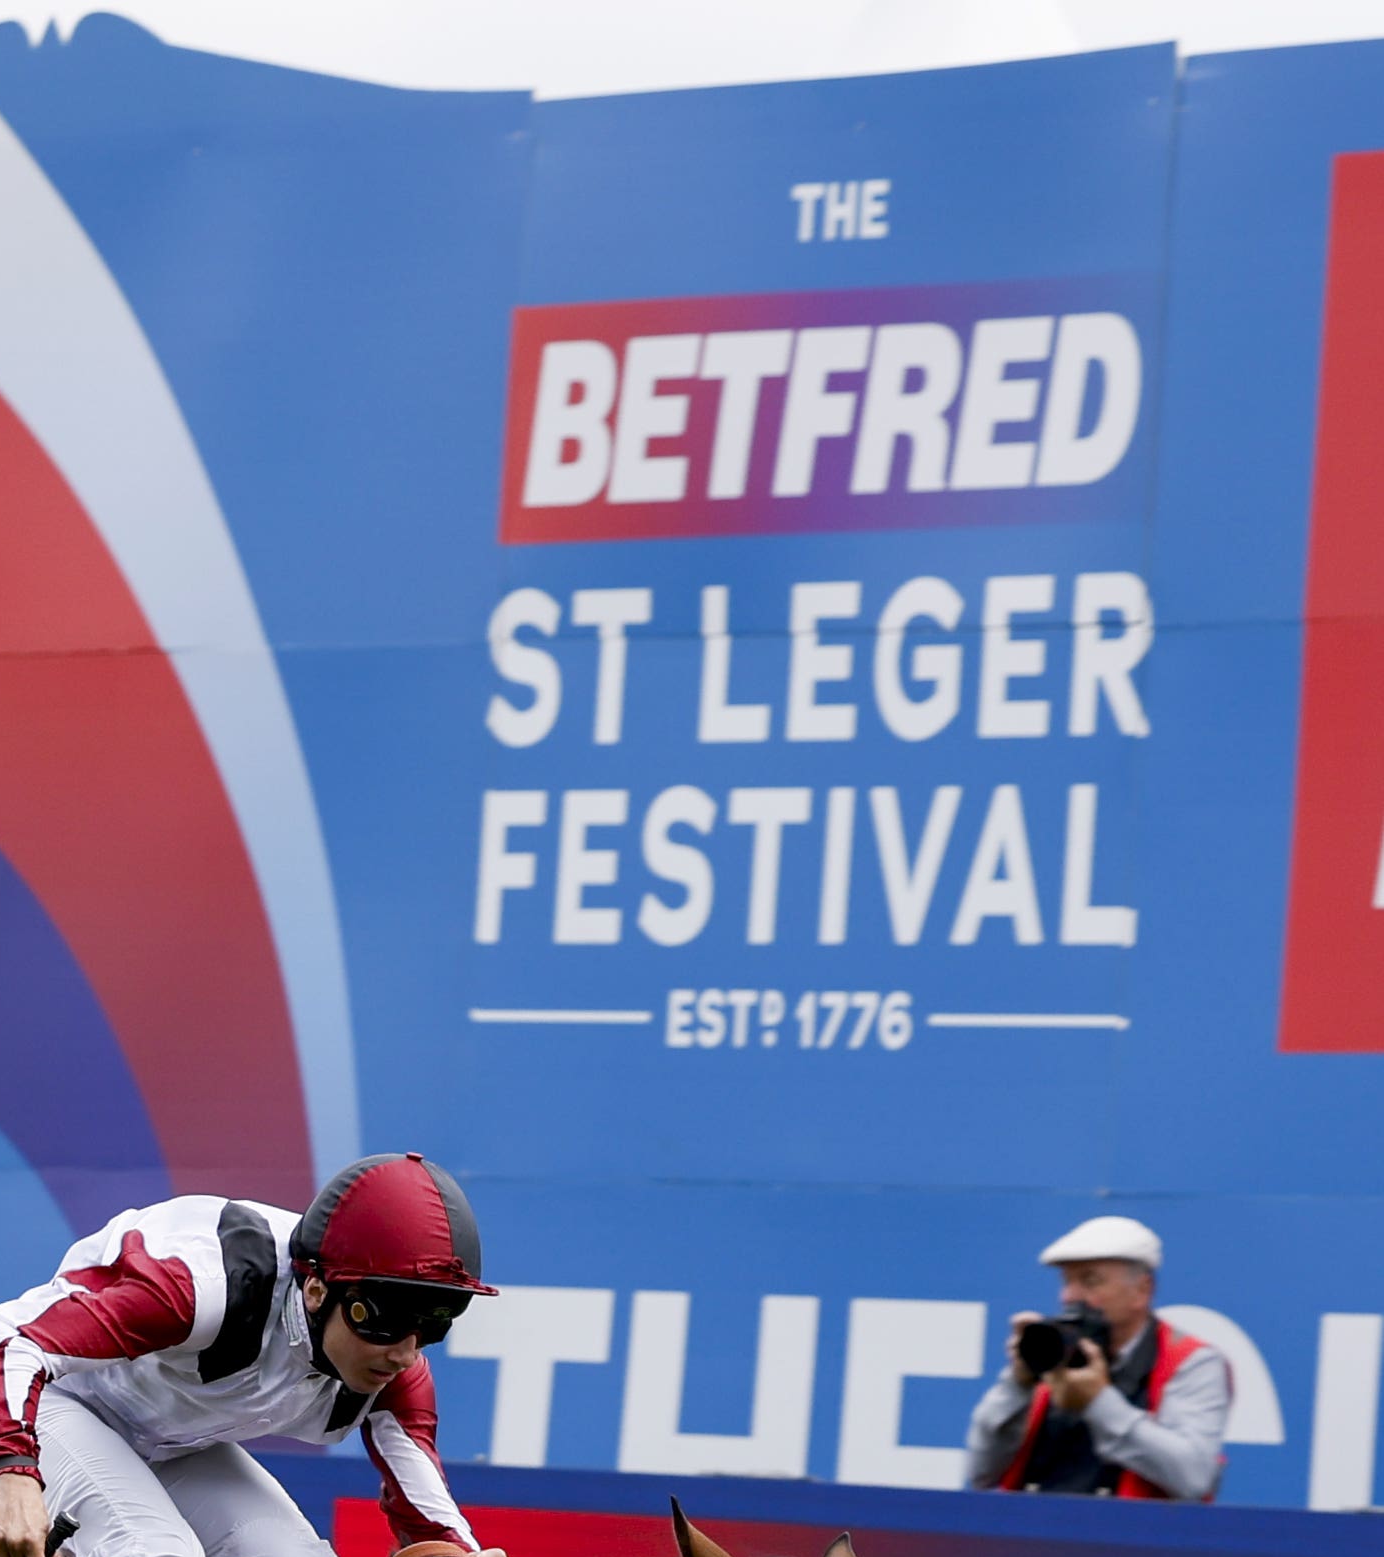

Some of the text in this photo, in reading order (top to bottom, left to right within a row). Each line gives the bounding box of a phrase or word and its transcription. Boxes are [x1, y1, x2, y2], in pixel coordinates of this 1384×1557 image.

[790, 178, 891, 242] THE
[521, 311, 1143, 508] BETFRED
[486, 571, 1154, 748] ST LEGER
[473, 783, 1138, 947] FESTIVAL
[795, 991, 913, 1050] 1776
